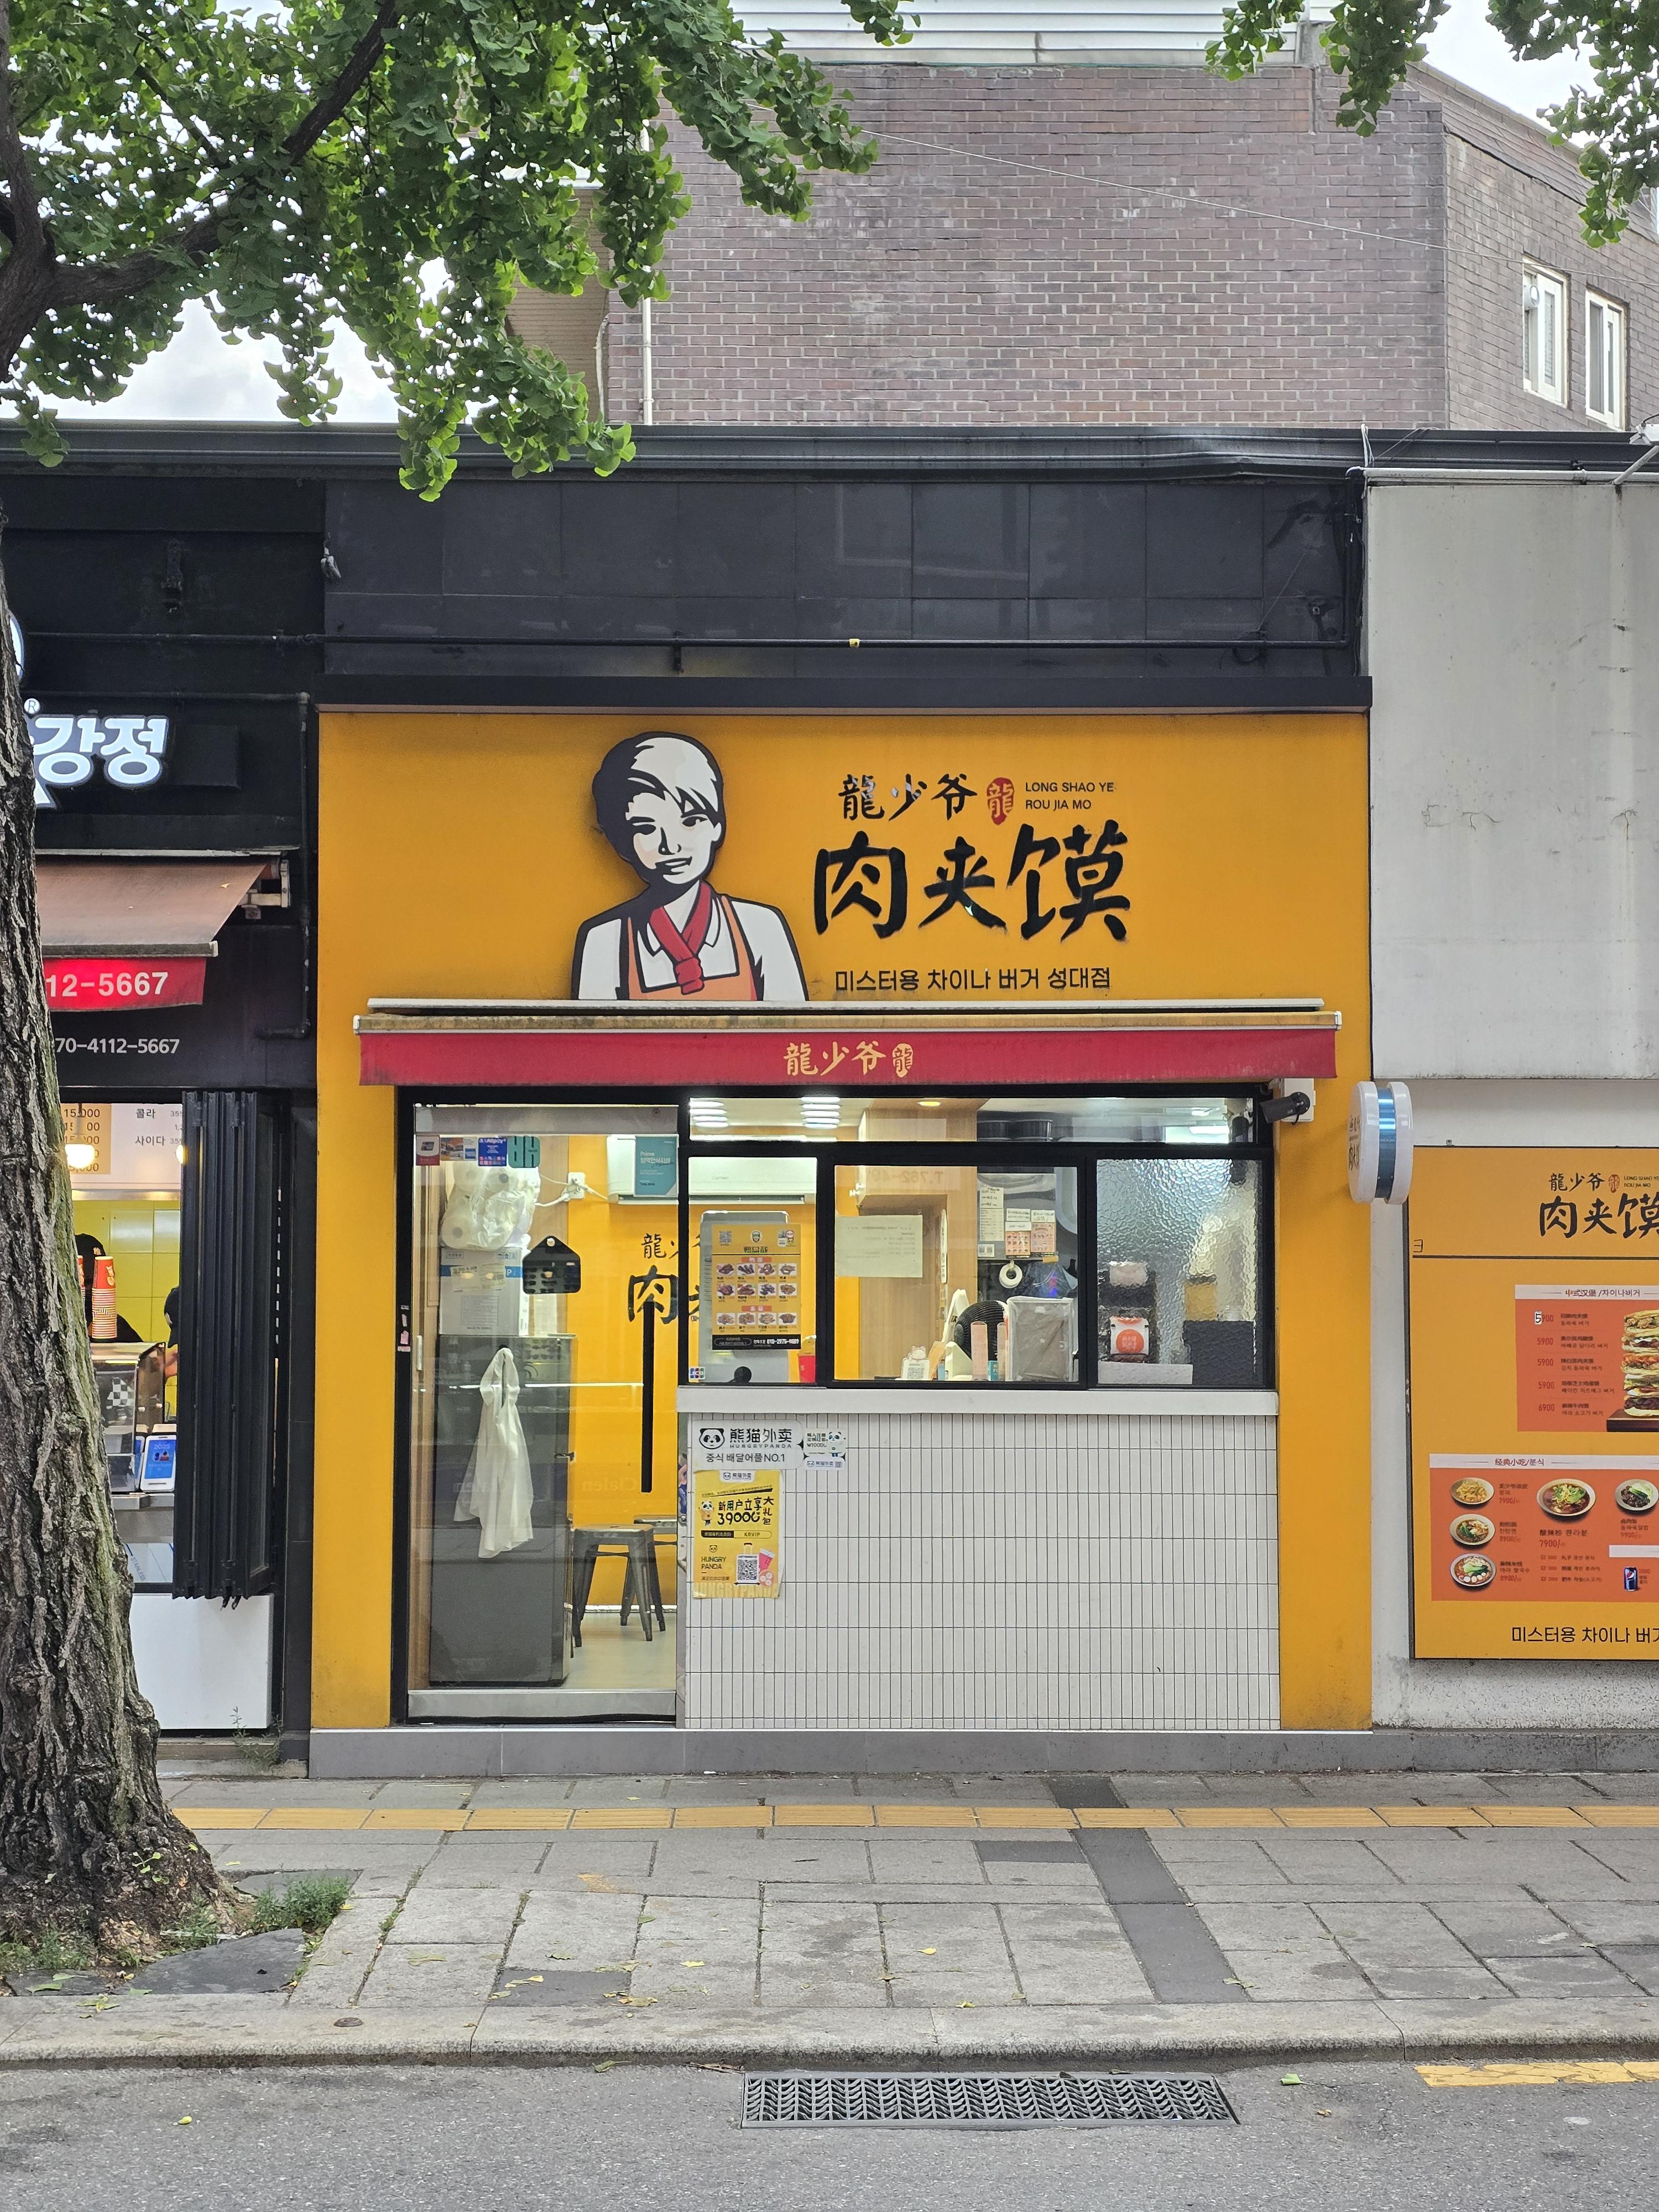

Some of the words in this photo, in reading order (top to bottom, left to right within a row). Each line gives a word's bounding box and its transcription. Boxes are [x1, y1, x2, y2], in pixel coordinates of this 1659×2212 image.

[29, 718, 166, 784] 강정
[1025, 782, 1058, 792] LONG
[1062, 782, 1095, 792] SHAO
[1099, 782, 1114, 792] YE
[1025, 800, 1050, 810] ROU
[1053, 800, 1068, 811] JIA
[1072, 800, 1092, 810] MO
[813, 820, 1130, 941] 肉夹馍
[835, 969, 920, 990] 미스터용
[927, 968, 991, 990] 차이나
[998, 968, 1039, 990] 버거
[1047, 967, 1110, 989] 성대점
[46, 972, 168, 997] 12-5667
[55, 1037, 180, 1053] 70-4112-5667
[64, 1108, 100, 1118] 15000
[135, 1135, 165, 1146] 사이다
[1537, 1337, 1553, 1345] 5900
[1537, 1358, 1553, 1366] 5900
[1538, 1381, 1554, 1390] 5900
[730, 1428, 792, 1443] 熊猫外卖
[706, 1453, 724, 1463] 중식
[1512, 1626, 1575, 1643] 미스터용
[1582, 1626, 1630, 1643] 차이나
